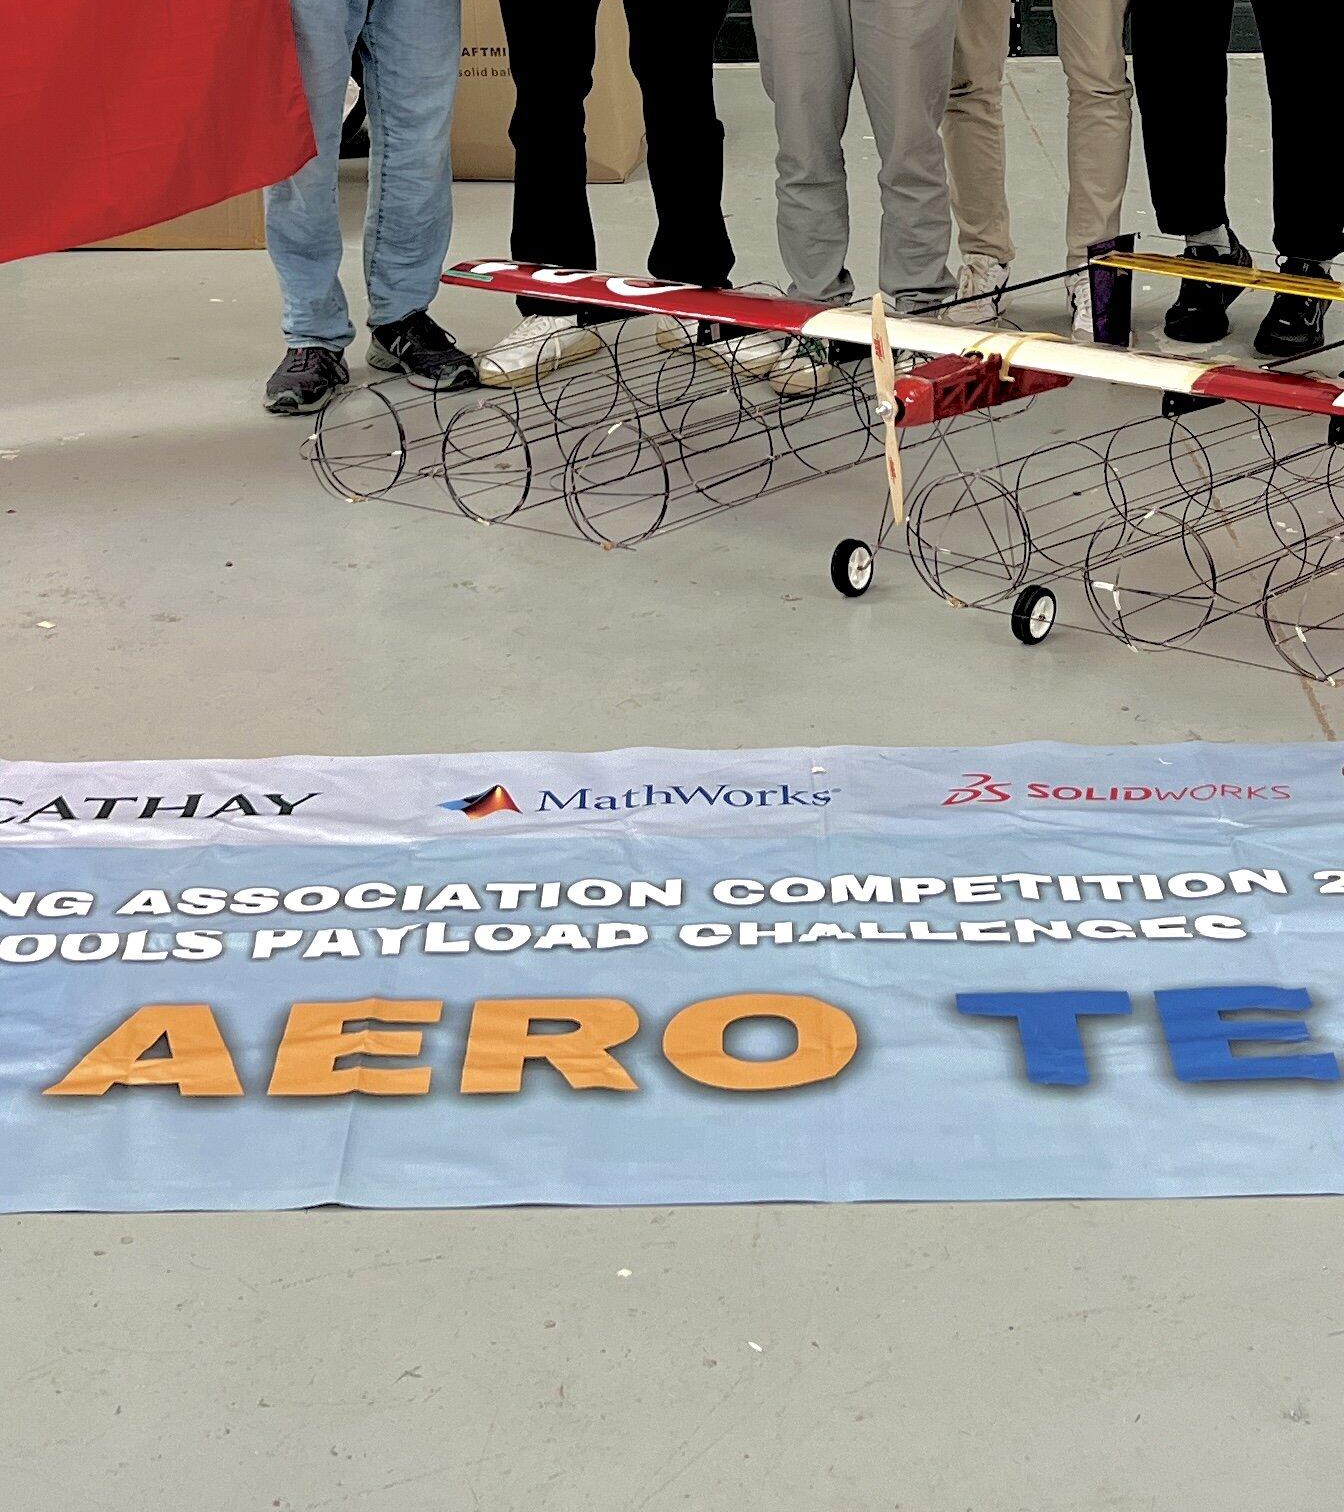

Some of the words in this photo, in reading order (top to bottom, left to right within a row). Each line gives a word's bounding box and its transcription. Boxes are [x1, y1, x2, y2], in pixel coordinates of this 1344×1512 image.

[537, 784, 832, 812] MathWorks
[1027, 782, 1292, 802] SOLIDWORKS
[116, 877, 684, 917] ASSOCIATION
[712, 865, 1288, 908] COMPETITION
[250, 921, 649, 960] PAYLOAD
[678, 915, 1248, 946] CHALLENGES
[42, 993, 859, 1097] AERO
